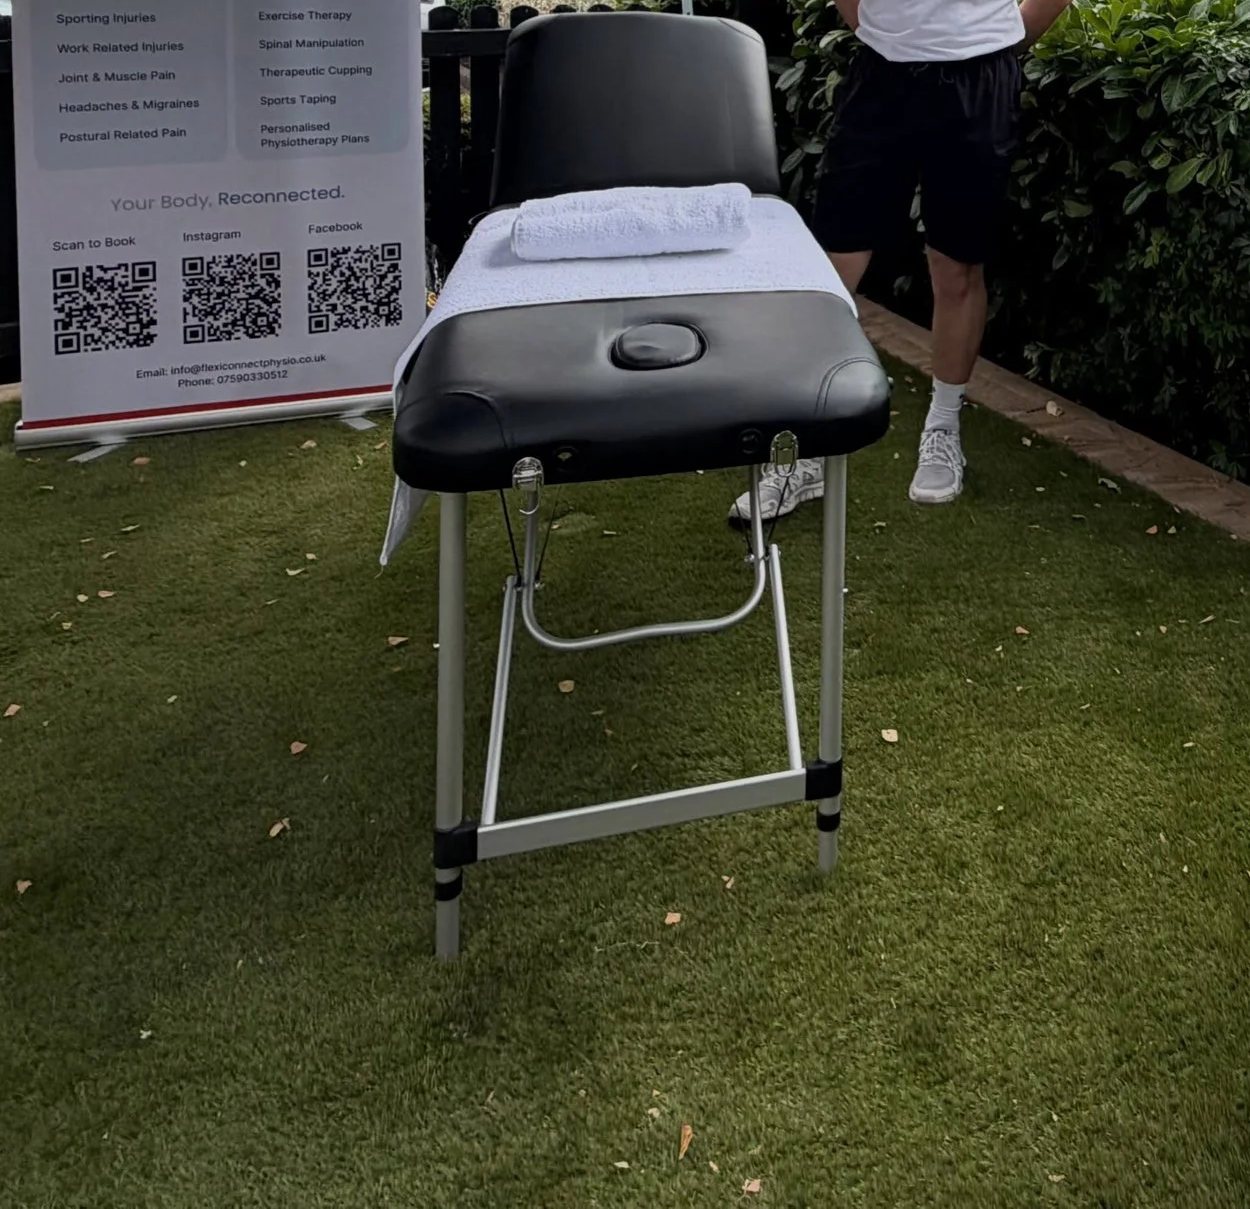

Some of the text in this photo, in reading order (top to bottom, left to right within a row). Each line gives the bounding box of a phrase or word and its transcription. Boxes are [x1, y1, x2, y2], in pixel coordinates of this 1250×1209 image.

[56, 12, 156, 26] Sporting Injuries
[258, 10, 352, 21] Exercise Therapy
[57, 41, 184, 54] Work Related Injuries
[259, 38, 365, 50] Spinal Manipulation
[58, 70, 176, 84] Joint & Muscle Pain
[259, 65, 373, 78] Therapeutic Cupping
[58, 99, 200, 113] Headaches & Migraines
[260, 94, 337, 106] Sports Taping
[59, 127, 187, 143] Postural Related Pain
[260, 122, 330, 134] Personalised
[261, 134, 370, 149] Physiotherapy Plans
[111, 186, 345, 212] Your Body, Reconnected.
[308, 221, 363, 234] Facebook
[182, 228, 241, 243] Instagram
[52, 235, 136, 252] Scan to Book
[136, 354, 327, 379] Email: info@flexiconnectphysio.co.uk
[178, 369, 288, 388] Phone: 07590330512
